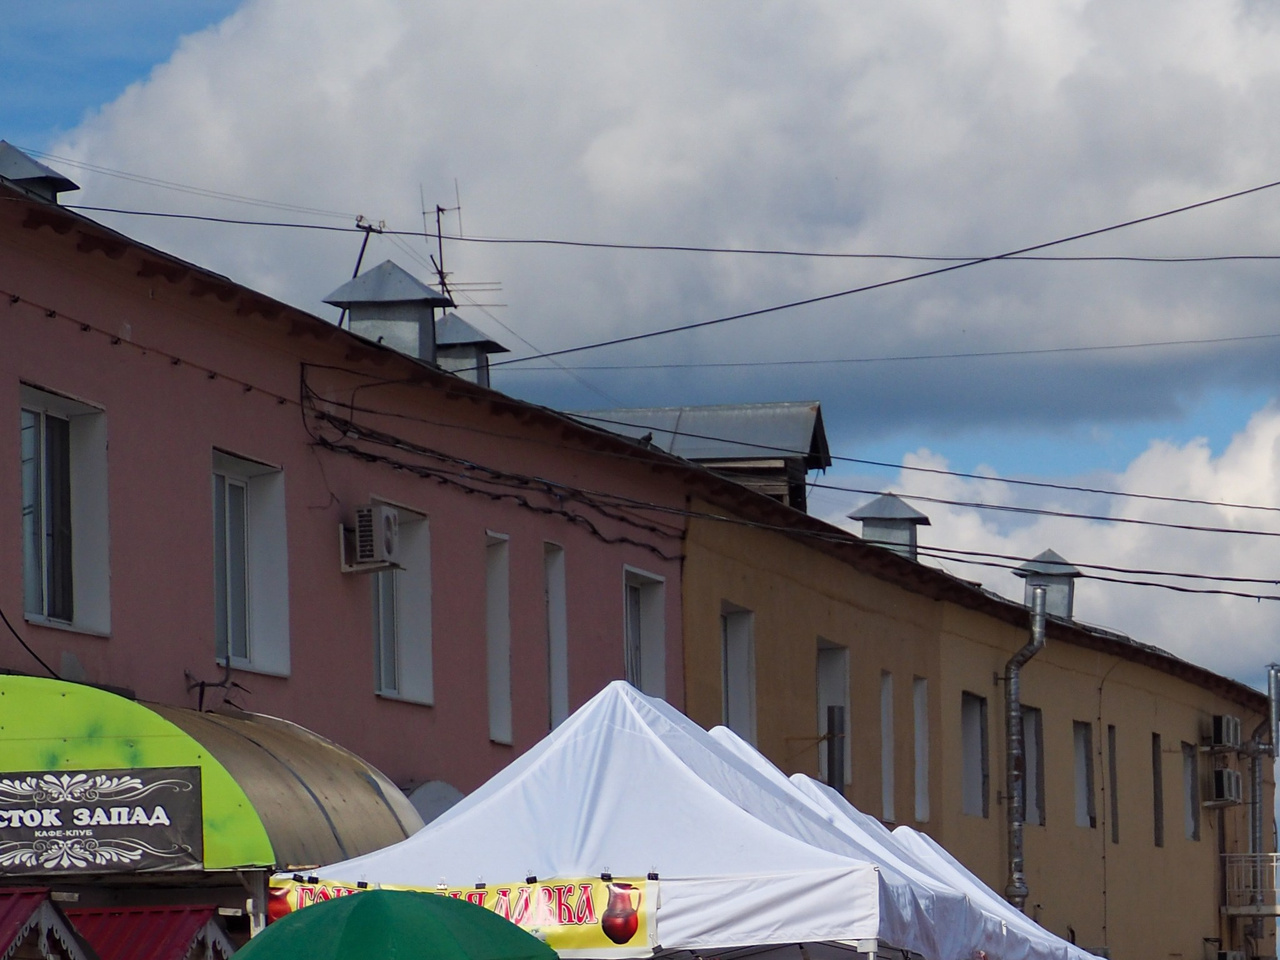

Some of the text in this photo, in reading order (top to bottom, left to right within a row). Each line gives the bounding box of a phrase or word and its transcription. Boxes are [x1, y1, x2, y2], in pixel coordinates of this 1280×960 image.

[73, 806, 170, 826] ЗАПАД
[34, 829, 93, 837] КАФЕ-КЛУБ
[494, 883, 599, 926] ЛАВКА
